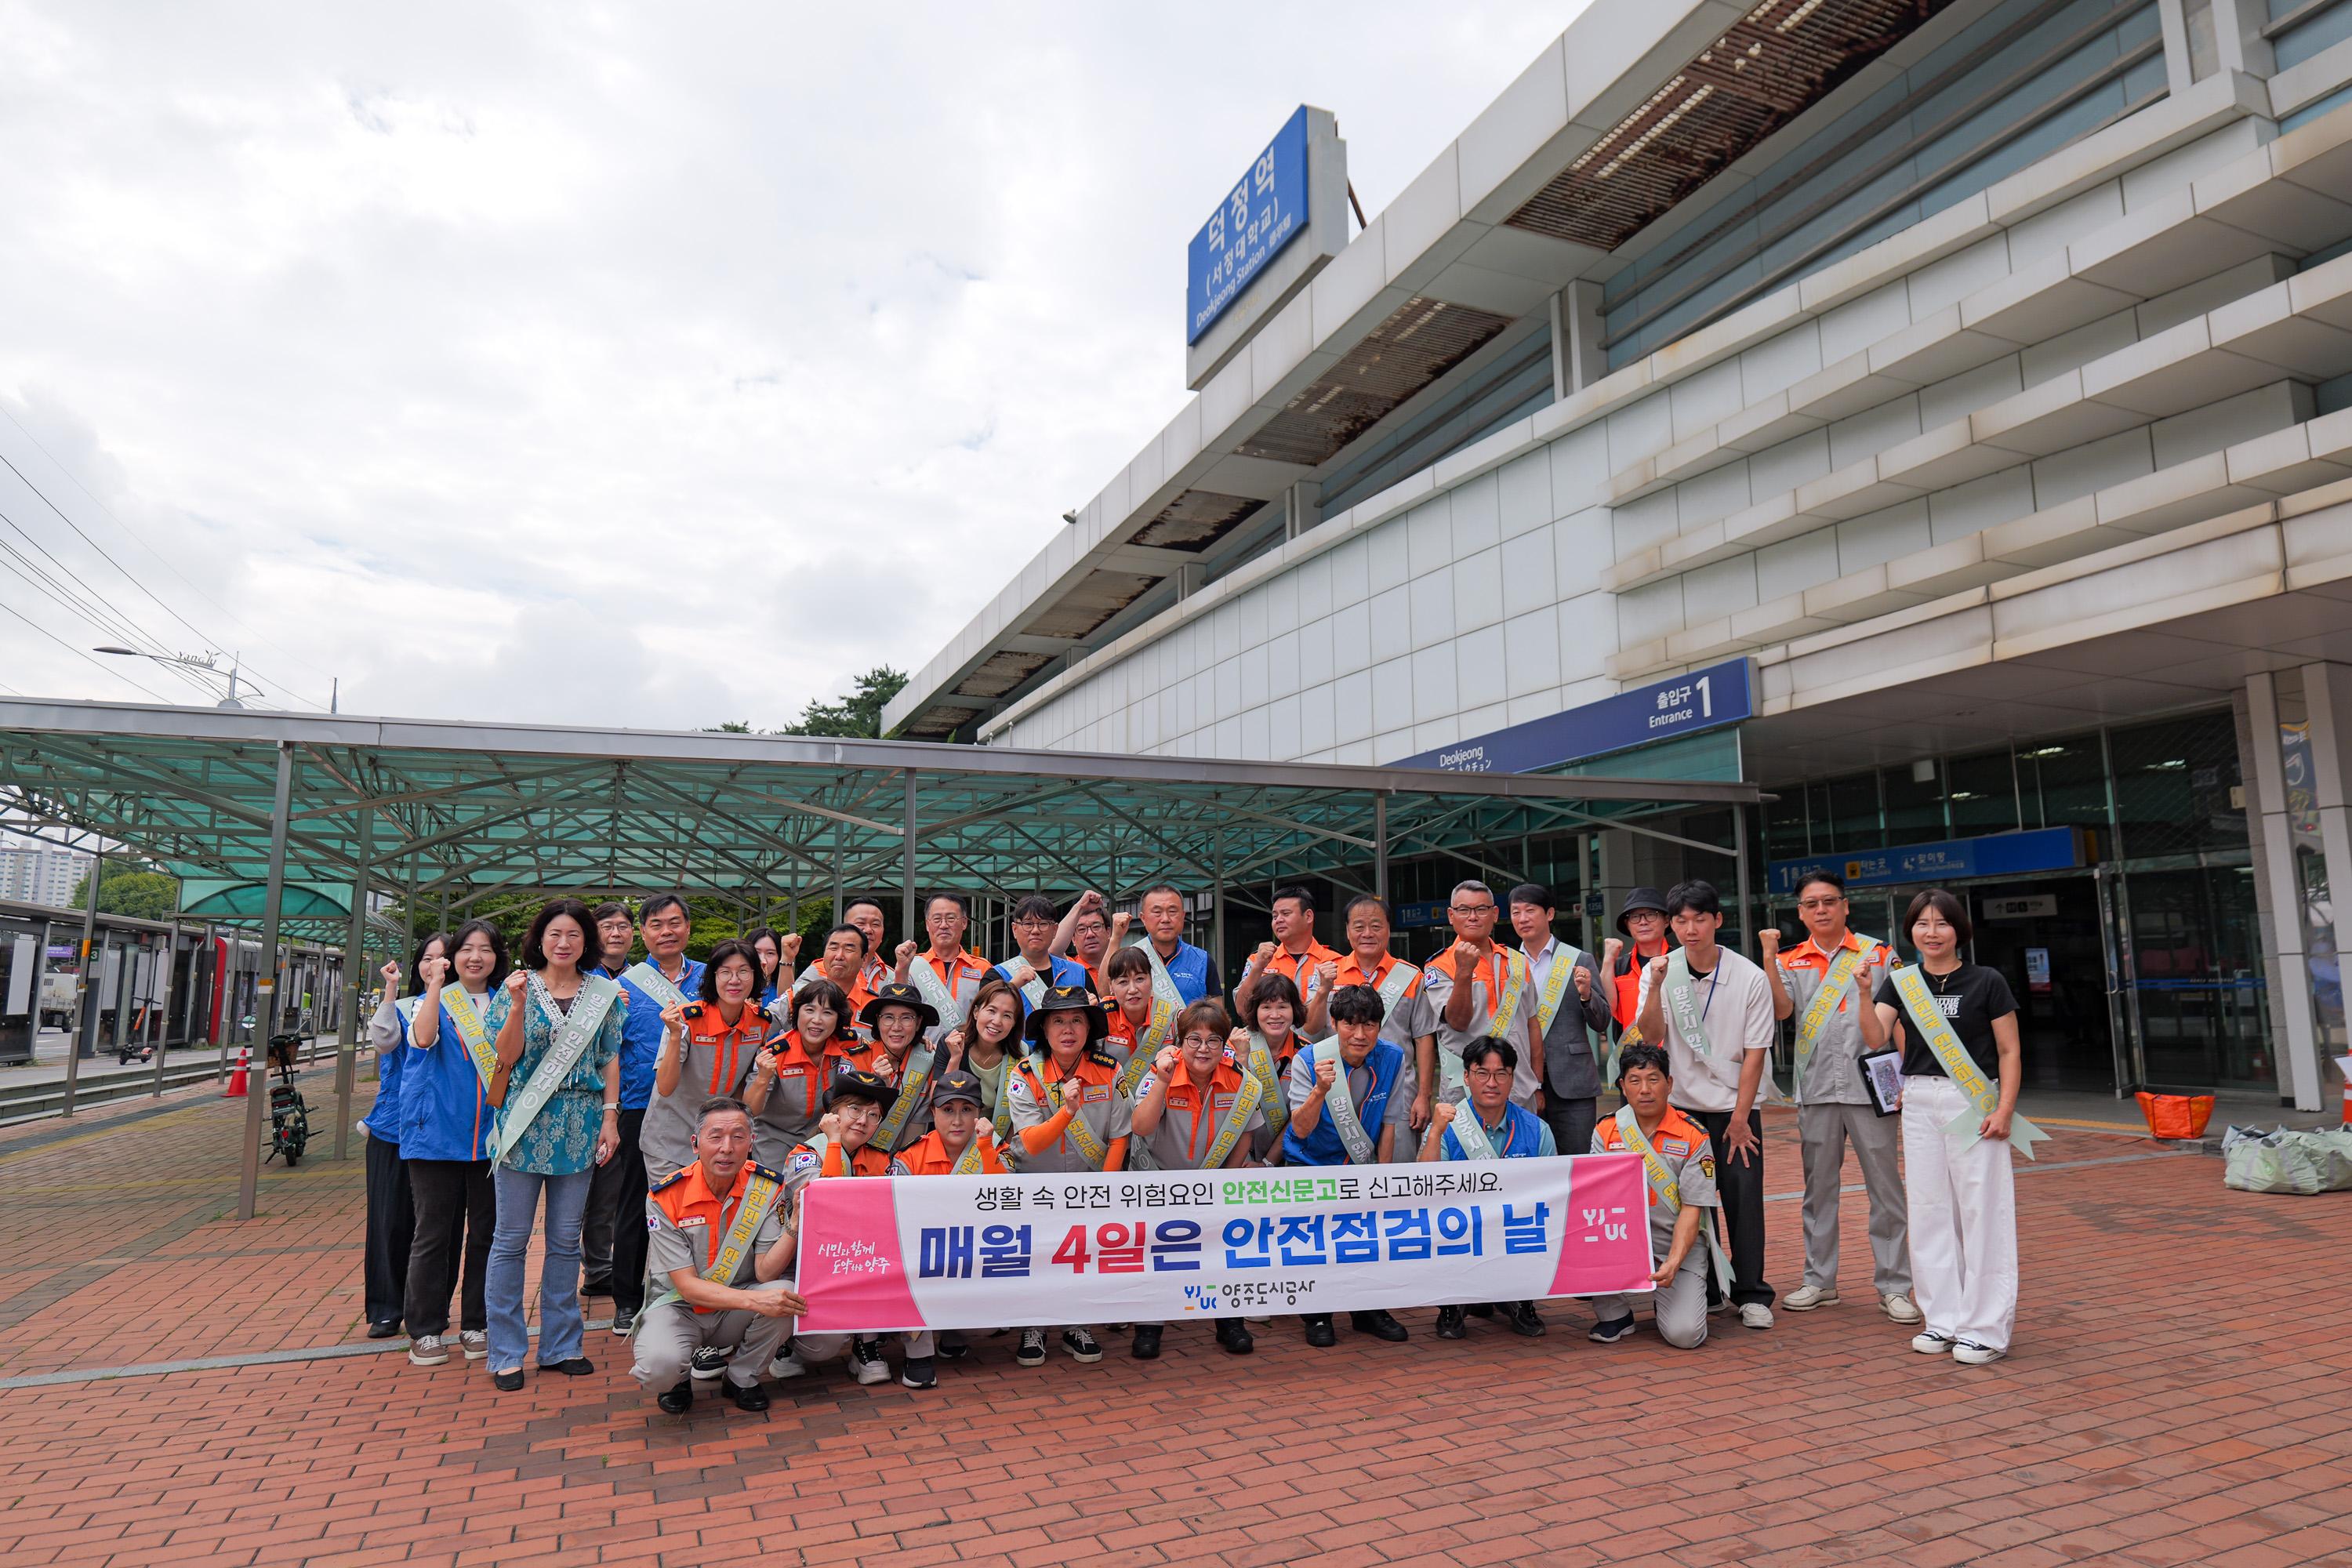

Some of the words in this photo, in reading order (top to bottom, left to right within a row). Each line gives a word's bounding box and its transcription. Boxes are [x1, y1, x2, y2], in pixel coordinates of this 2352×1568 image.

[1208, 144, 1276, 252] 덕정역
[1206, 196, 1279, 297] (서정대학교)
[1196, 278, 1236, 329] Deokjeong
[1236, 244, 1266, 285] Station
[1649, 708, 1693, 728] Entrance
[1657, 685, 1693, 710] 출입구
[1696, 676, 1711, 718] 1
[1439, 746, 1484, 767] Deokjeong
[1780, 866, 1788, 887] 1
[91, 951, 99, 960] 3
[918, 970, 946, 1004] 양주시
[1545, 956, 1571, 1004] 대한민국
[443, 988, 485, 1039] 대한민국
[579, 992, 609, 1033] 양주시
[1142, 999, 1171, 1058] 대한민국
[1673, 985, 1698, 1031] 양주시
[1797, 985, 1839, 1040] 안전하자
[1900, 973, 1942, 1030] 대한민국
[1933, 1032, 1987, 1098] 안전하자
[532, 1031, 584, 1093] 안전하자
[1250, 1049, 1279, 1104] 대한민국
[889, 1069, 924, 1127] 대한민국
[1331, 1096, 1362, 1141] 양주시
[1455, 1109, 1485, 1153] 양주시
[734, 1175, 774, 1245] 대한민국
[975, 1187, 1023, 1210] 생활
[1032, 1187, 1055, 1210] 속
[1064, 1185, 1111, 1209] 안전
[1120, 1181, 1214, 1208] 위험요인
[1222, 1177, 1360, 1205] 안전신문고로
[1369, 1172, 1503, 1200] 신고해주세요.
[818, 1242, 850, 1257] 시민과
[851, 1240, 876, 1257] 함께
[919, 1224, 1032, 1279] 매월
[1051, 1219, 1203, 1274] 4일은
[1222, 1205, 1483, 1269] 안전점검의
[1503, 1202, 1550, 1254] 날
[833, 1258, 864, 1275] 도약하는
[865, 1257, 891, 1274] 양주
[1222, 1279, 1316, 1308] 양주도시공사
